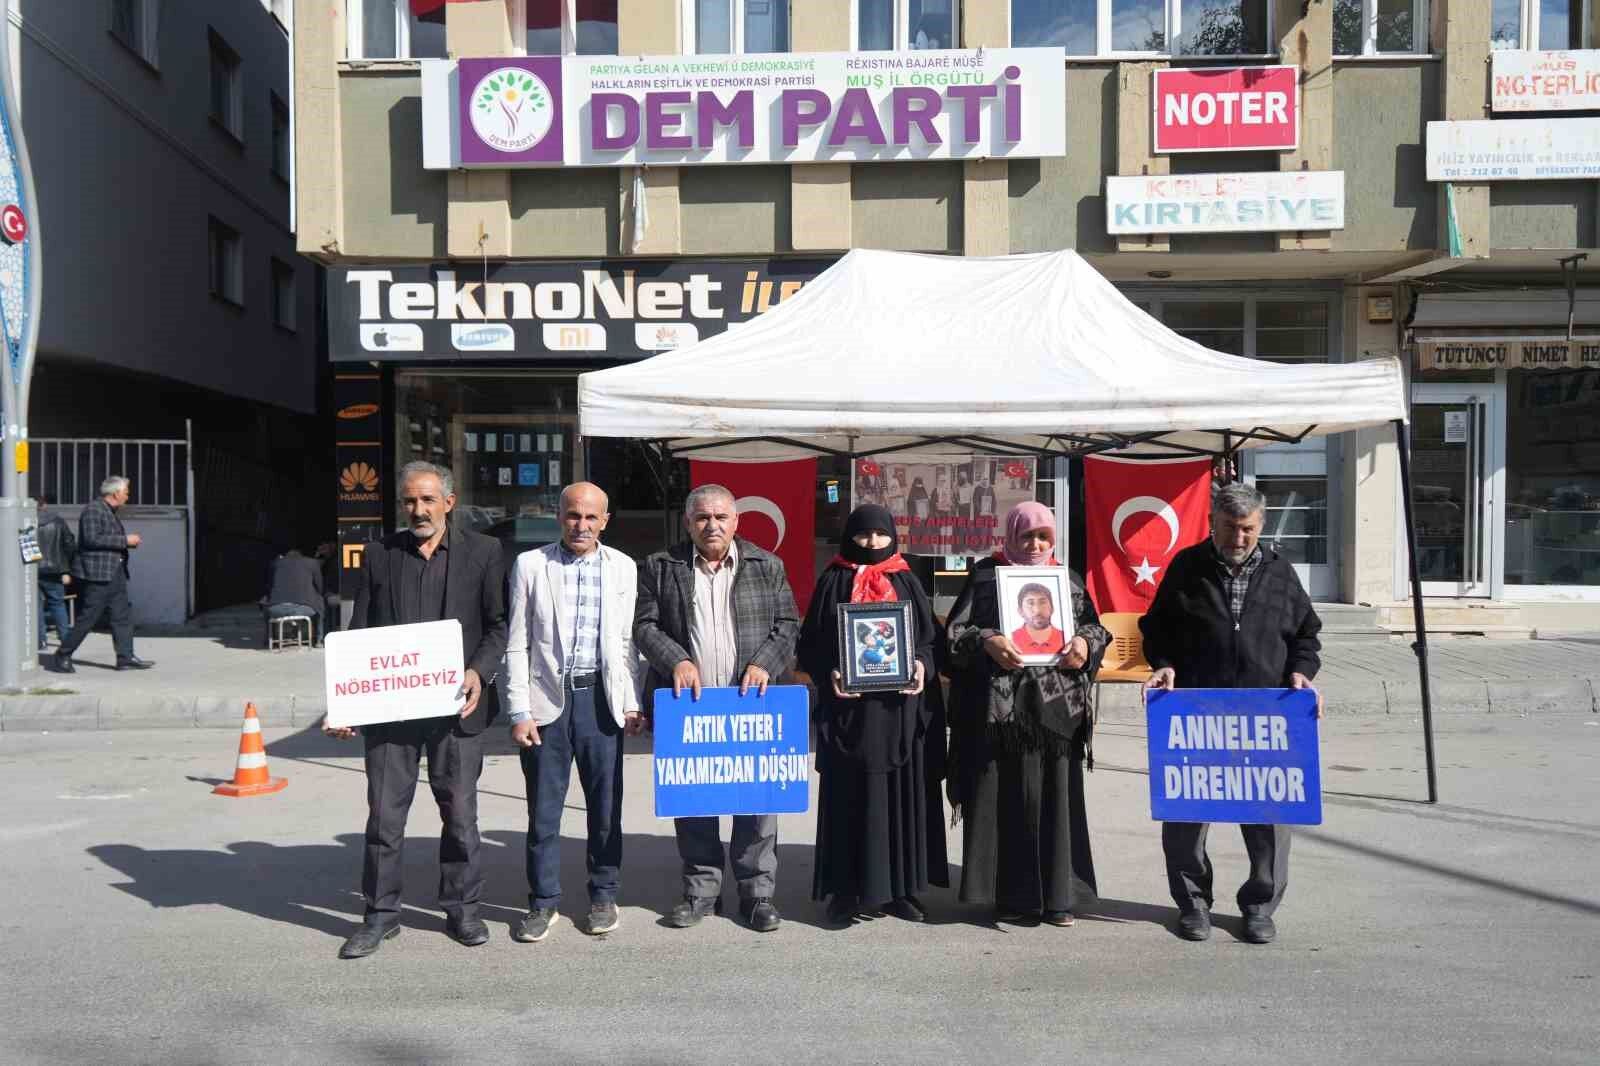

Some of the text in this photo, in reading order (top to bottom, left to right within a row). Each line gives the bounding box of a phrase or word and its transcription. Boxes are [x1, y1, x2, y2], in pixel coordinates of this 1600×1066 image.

[591, 73, 815, 90] HALKLARIN EŞİTLİK VE DEMOKRASİ PARTİSİ
[632, 63, 670, 74] GELAN
[846, 70, 984, 89] MUŞ İL ÖRGÜTÜ
[591, 65, 1022, 150] DEM PARTİ
[1164, 90, 1289, 126] NOTER
[1114, 196, 1337, 226] KIRTASİYE
[346, 270, 725, 319] TeknoNet
[1435, 343, 1507, 363] TÜTÜNCÜ
[1522, 343, 1569, 363] NİMET
[370, 652, 421, 670] EVLAT
[335, 668, 458, 696] NÖBETİNDEYİZ
[682, 715, 727, 744] ARTIK
[730, 713, 773, 742] YETER
[1167, 715, 1289, 751] ANNELER
[656, 747, 808, 790] YAKAMIZDAN DÜŞÜN
[1163, 756, 1306, 802] DİRENİYOR
